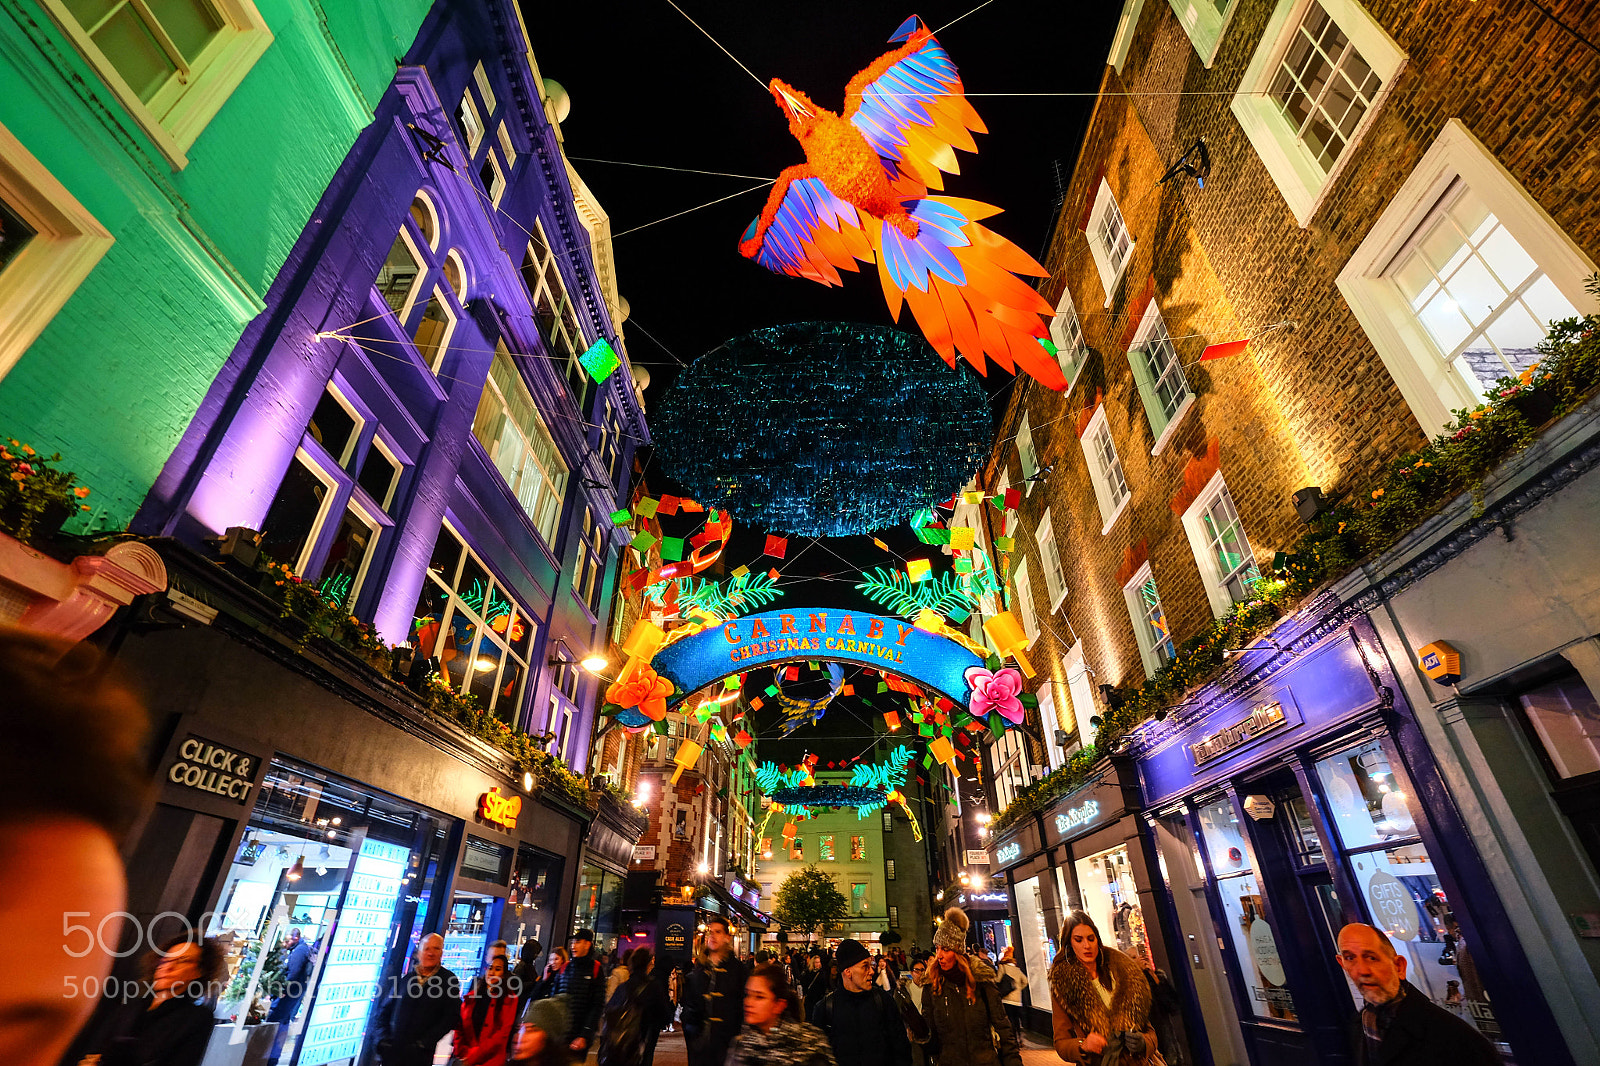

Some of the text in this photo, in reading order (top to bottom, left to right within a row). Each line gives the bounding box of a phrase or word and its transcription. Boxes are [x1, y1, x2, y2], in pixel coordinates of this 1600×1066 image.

[723, 613, 914, 647] CARNABY
[730, 637, 904, 664] CHRISTMAS CARNIVAL
[1425, 655, 1439, 669] ADT
[180, 739, 250, 777] CLICK &
[169, 762, 254, 800] COLLECT
[1370, 882, 1403, 900] GIFTS
[1380, 899, 1406, 916] FOR
[1386, 916, 1413, 932] HIM
